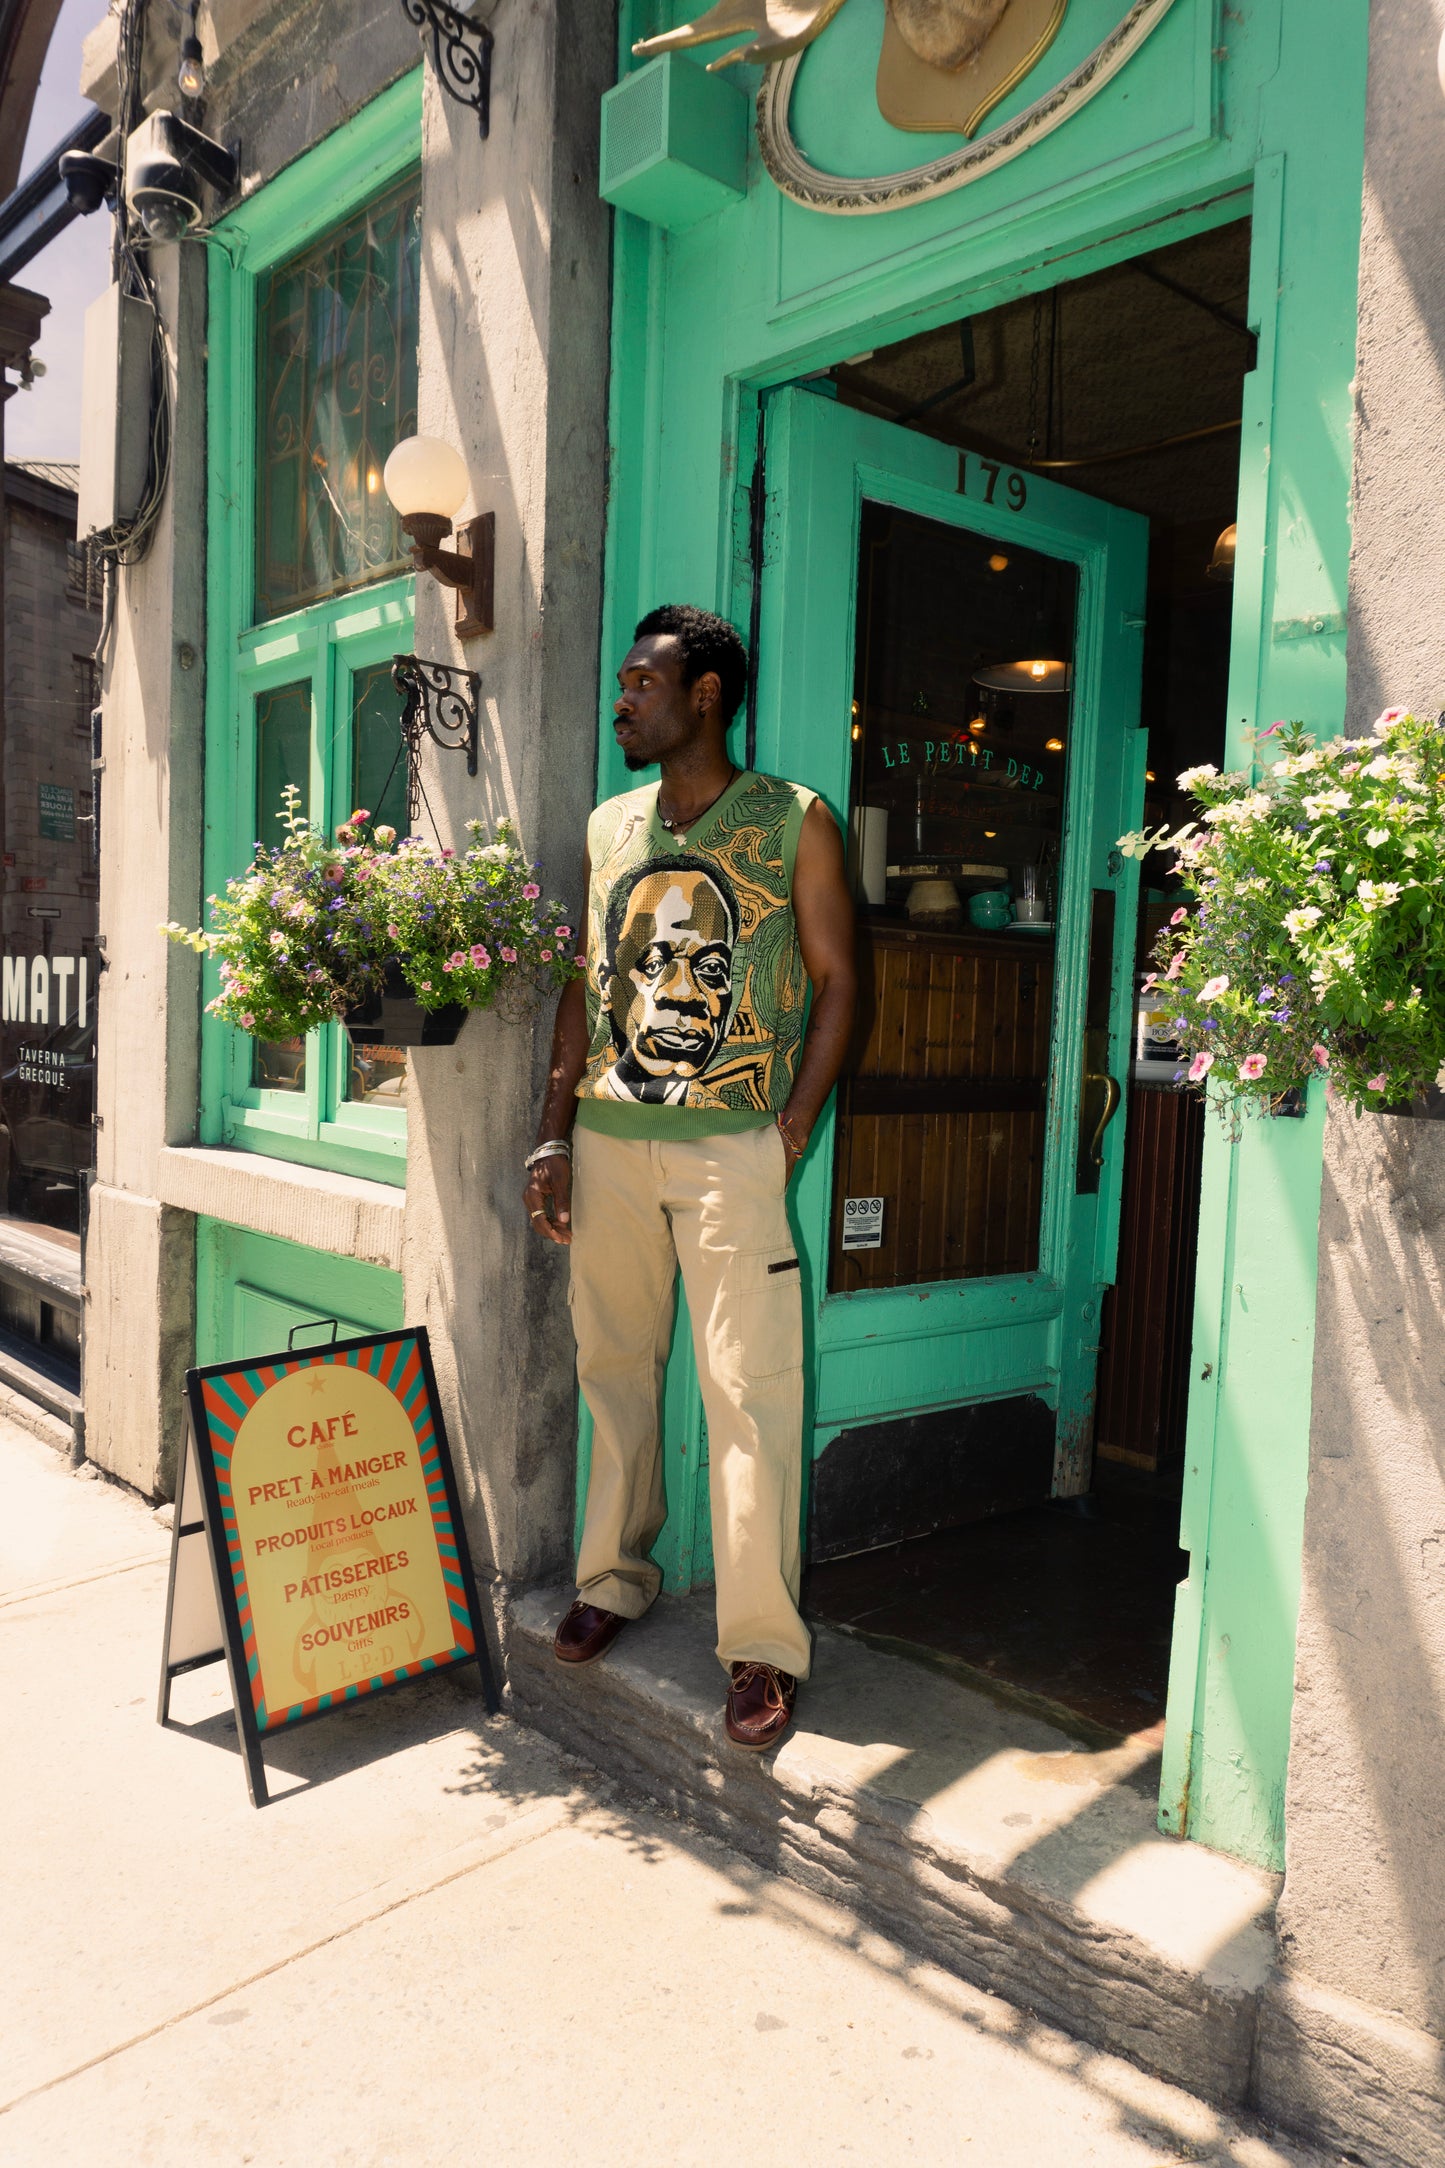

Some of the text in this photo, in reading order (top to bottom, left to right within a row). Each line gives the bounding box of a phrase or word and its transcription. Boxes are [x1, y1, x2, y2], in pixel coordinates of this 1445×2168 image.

[954, 451, 1027, 512] 179
[881, 741, 1044, 790] LE PETIT DEP
[2, 954, 87, 1028] MATI
[19, 1047, 66, 1067] TAVERNA
[19, 1066, 65, 1087] GRECQUE
[287, 1410, 359, 1448] CAFÉ
[286, 1478, 380, 1509] Ready-to-eat meals
[255, 1498, 418, 1556] PRODUITS LOCAUX
[311, 1528, 374, 1552] Local products
[333, 1585, 370, 1604] Pastry
[301, 1602, 410, 1651] SOUVENIRS
[347, 1637, 374, 1652] Gifts
